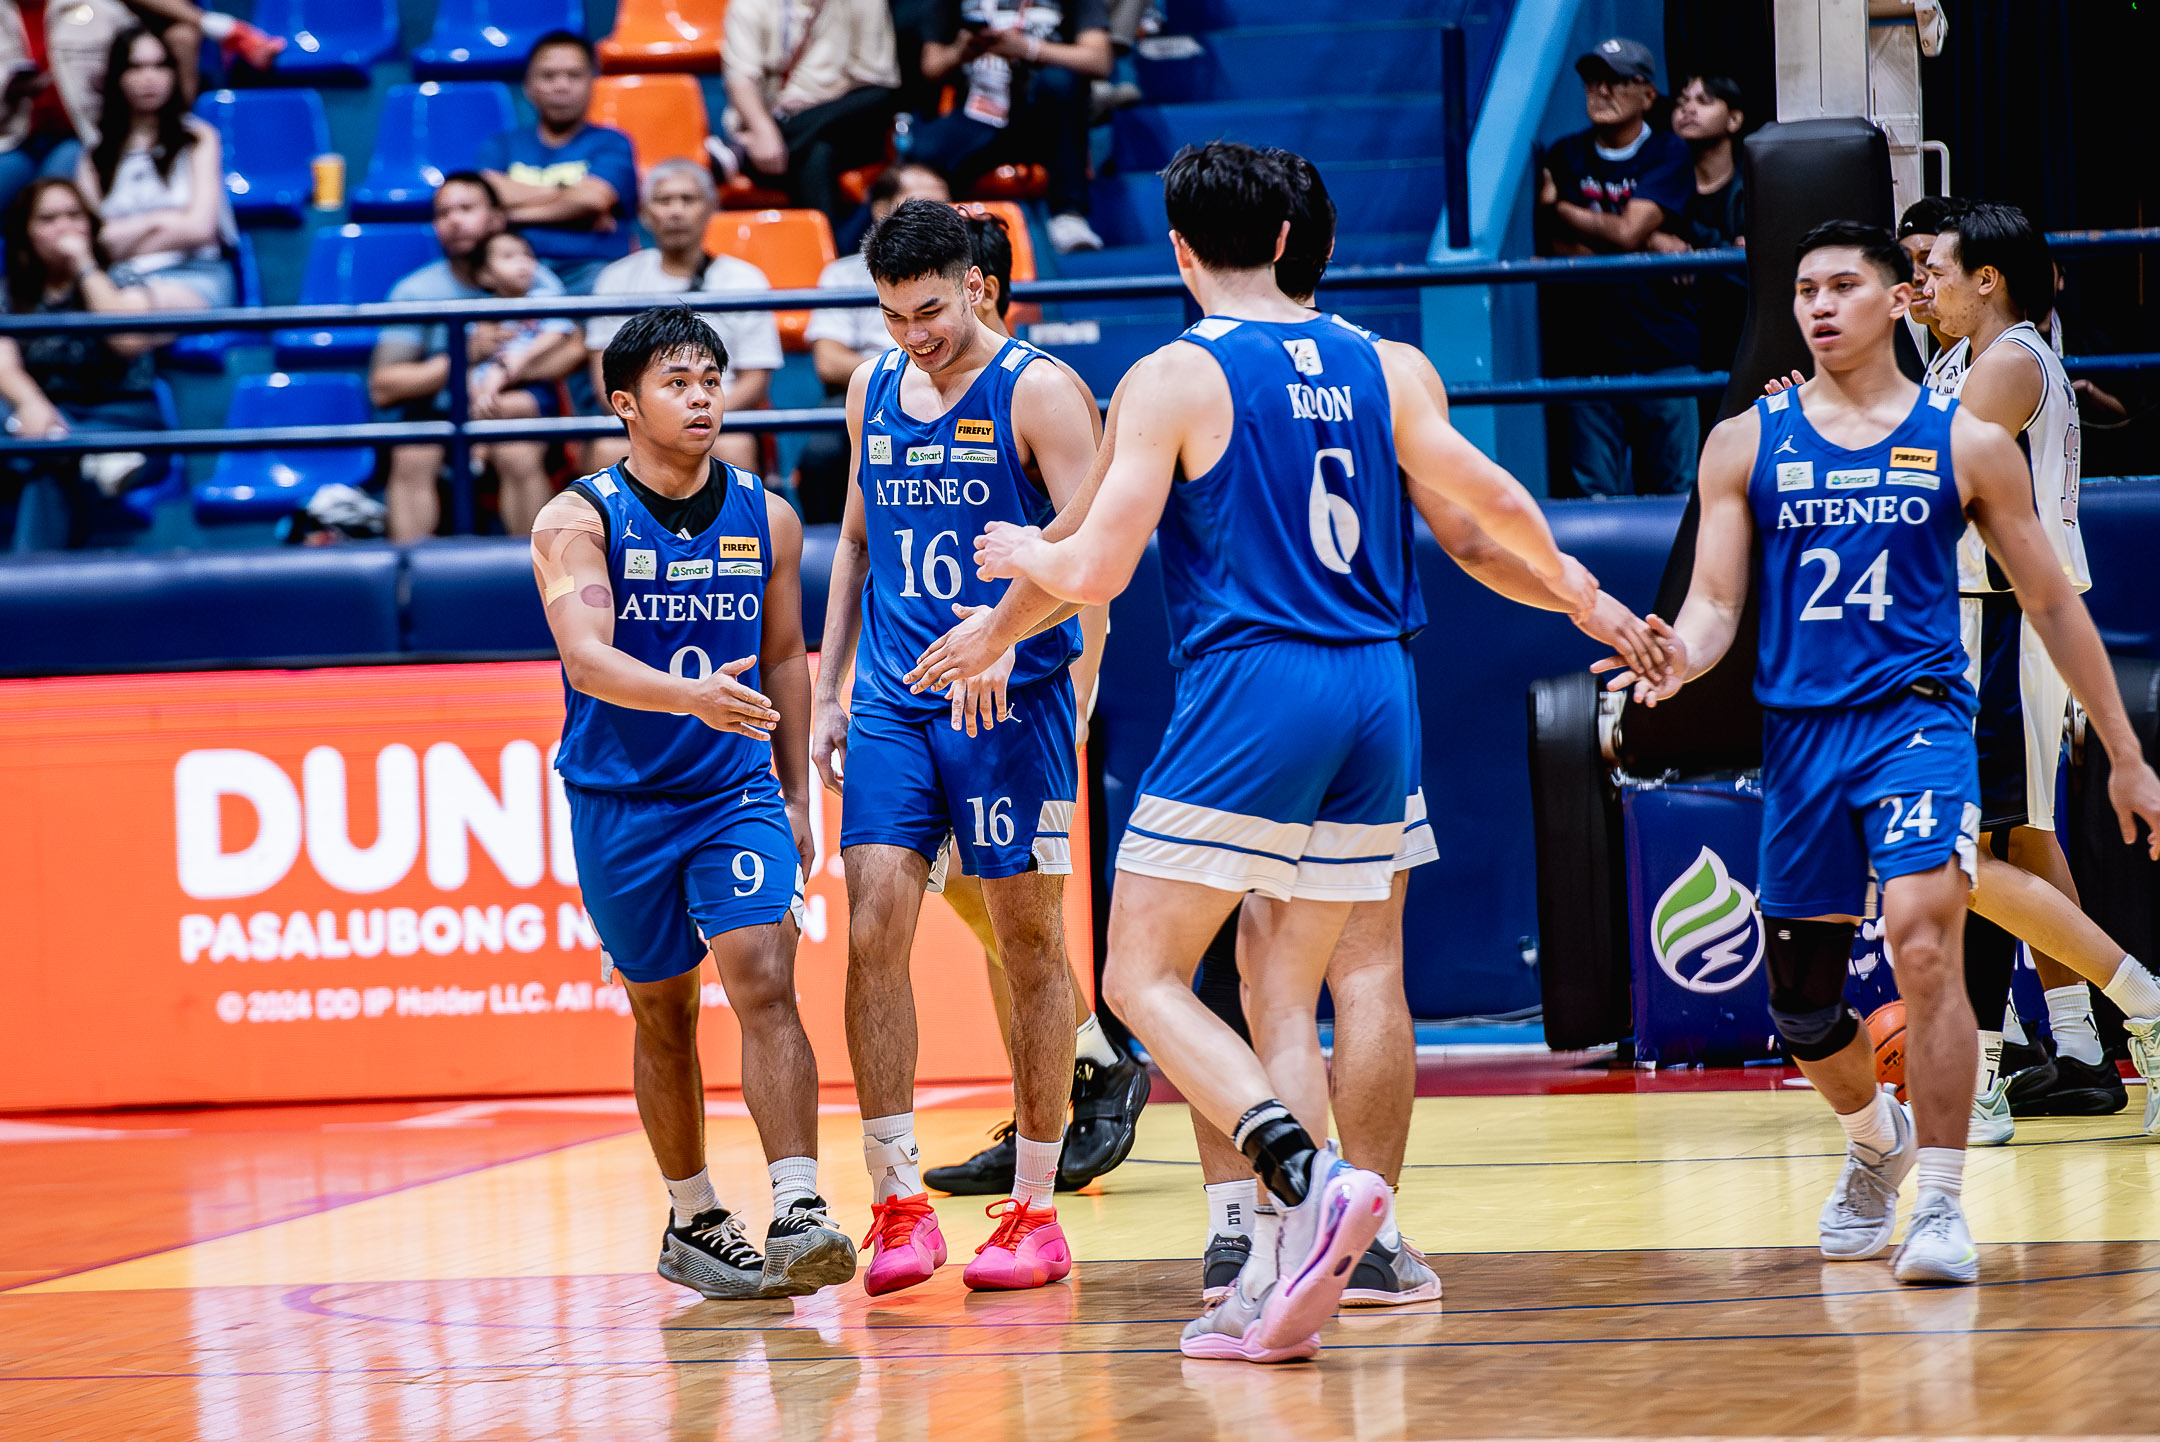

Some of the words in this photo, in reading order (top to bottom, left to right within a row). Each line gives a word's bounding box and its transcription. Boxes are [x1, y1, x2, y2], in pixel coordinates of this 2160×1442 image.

[957, 425, 993, 436] FIREFLY
[876, 478, 990, 506] ATENEO
[1308, 447, 1361, 575] 6
[1777, 495, 1931, 530] ATENEO
[722, 542, 757, 552] FIREFLY
[893, 528, 962, 600] 16
[680, 564, 710, 576] Smart
[1799, 547, 1894, 622] 24
[618, 593, 759, 622] ATENEO
[966, 796, 1015, 847] 16
[1879, 789, 1938, 845] 24
[731, 850, 766, 898] 9
[180, 903, 547, 963] PASALUBONG
[555, 982, 586, 1011] All
